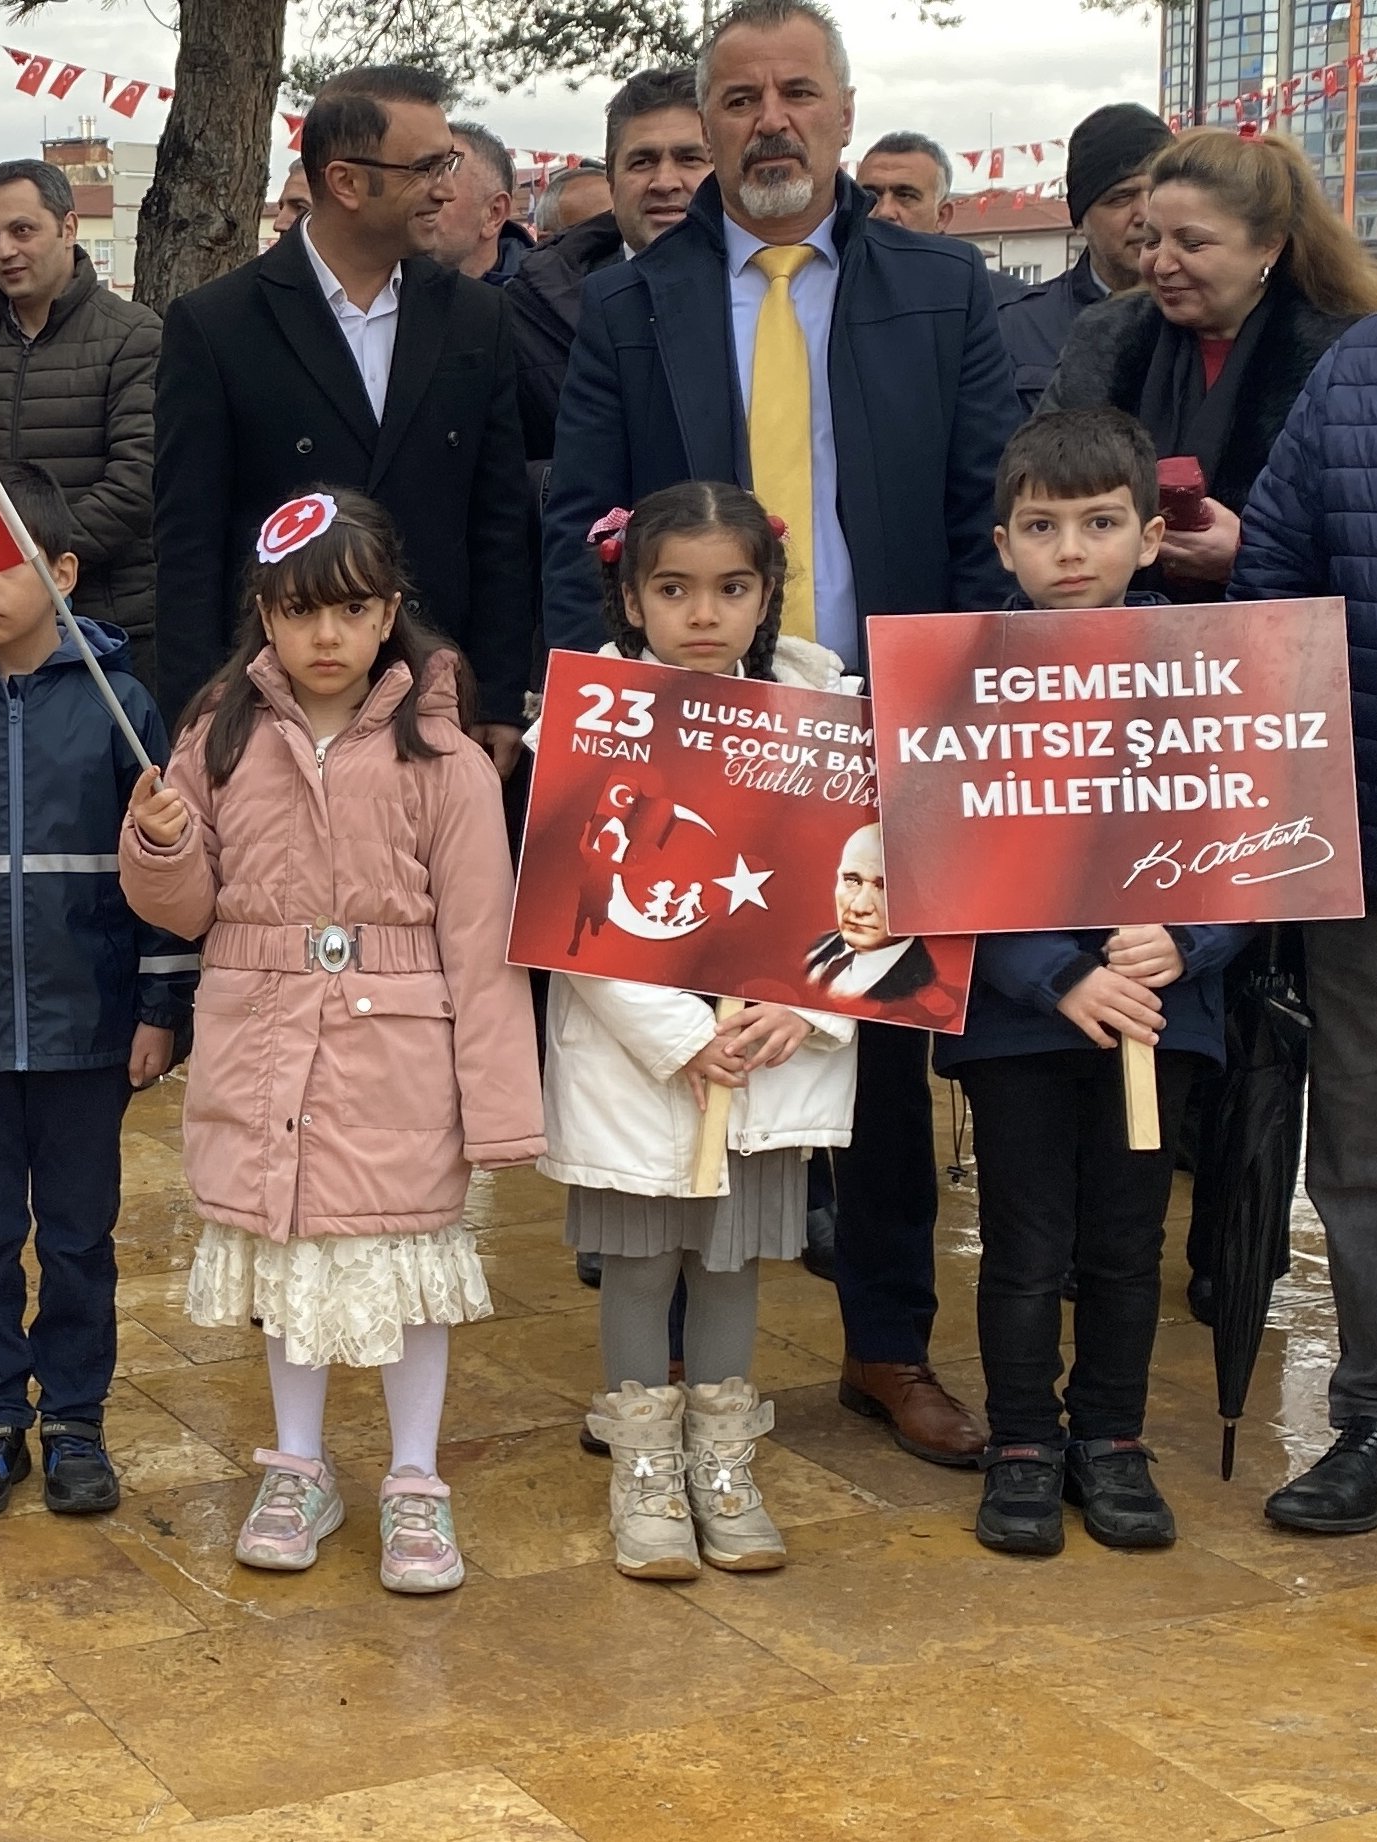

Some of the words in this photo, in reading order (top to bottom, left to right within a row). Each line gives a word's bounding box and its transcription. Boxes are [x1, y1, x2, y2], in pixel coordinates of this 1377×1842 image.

[974, 651, 1243, 703] EGEMENLİK
[575, 683, 656, 738] 23
[682, 700, 788, 734] ULUSAL
[572, 733, 651, 764] NİSAN
[678, 728, 714, 751] VE
[722, 735, 819, 768] ÇOCUK
[898, 720, 1115, 763] KAYITSIZ
[1126, 712, 1329, 768] ŞARTSIZ
[724, 756, 815, 797] Kutlu
[962, 763, 1269, 818] MİLLETİNDİR.
